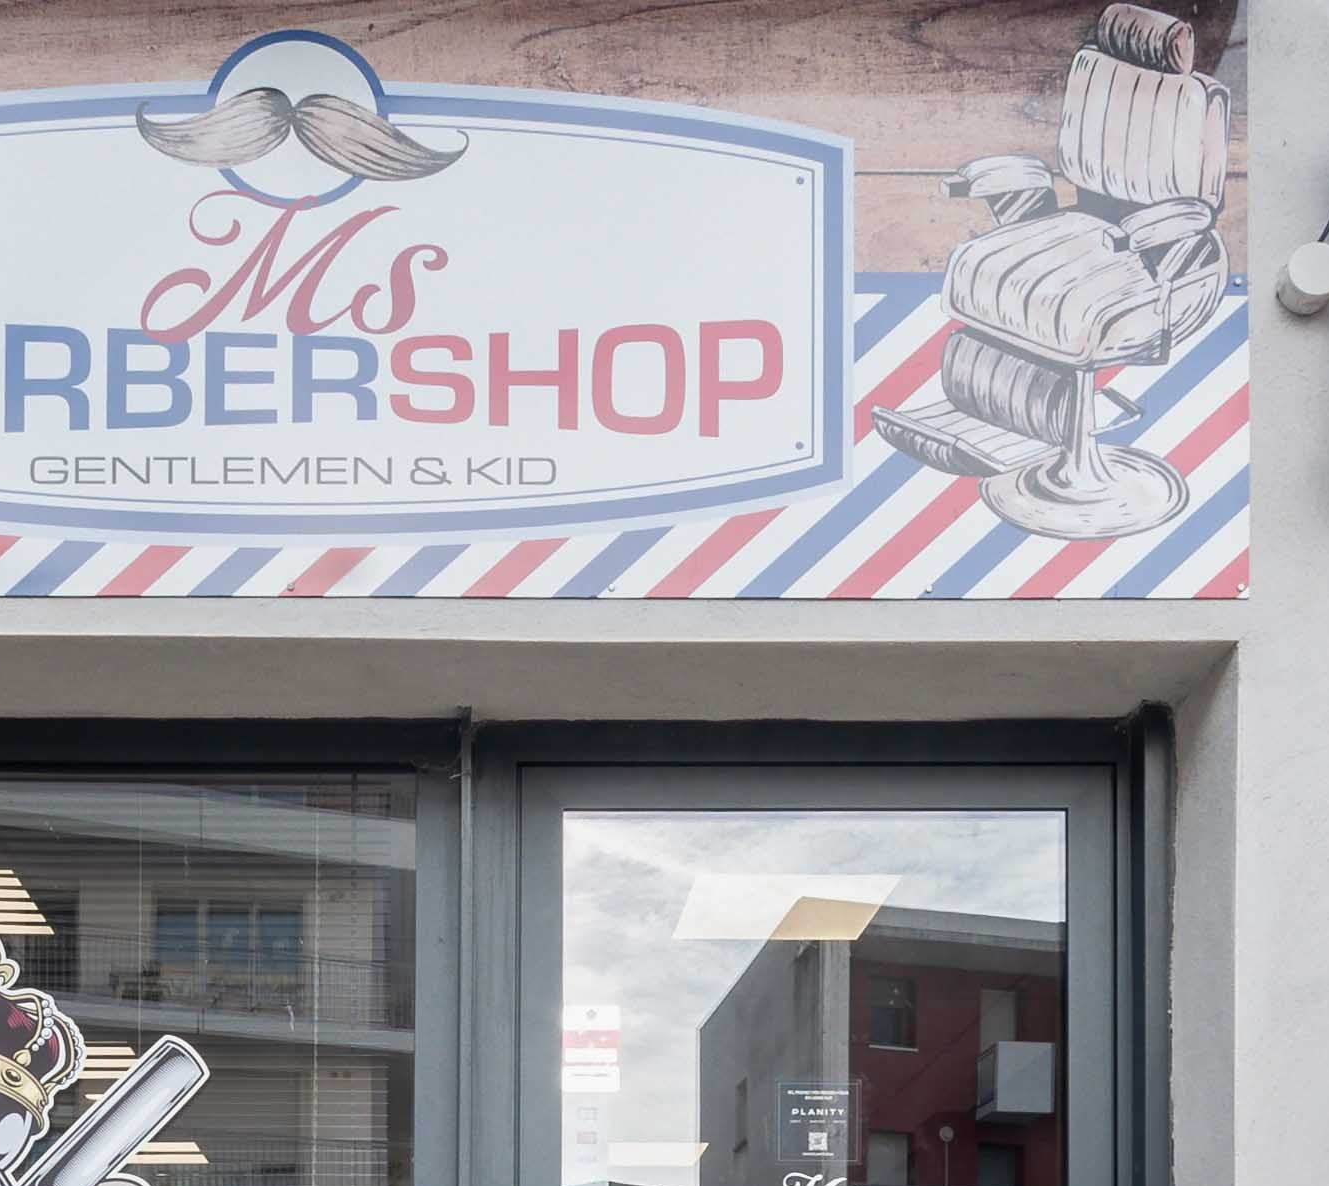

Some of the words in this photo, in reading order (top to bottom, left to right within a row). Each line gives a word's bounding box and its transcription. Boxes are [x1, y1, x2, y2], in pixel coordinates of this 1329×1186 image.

[140, 189, 448, 345] Ms
[29, 453, 399, 487] GENTLEMEN
[409, 455, 452, 486] &
[466, 455, 557, 486] KID
[791, 1108, 845, 1116] PLANITY
